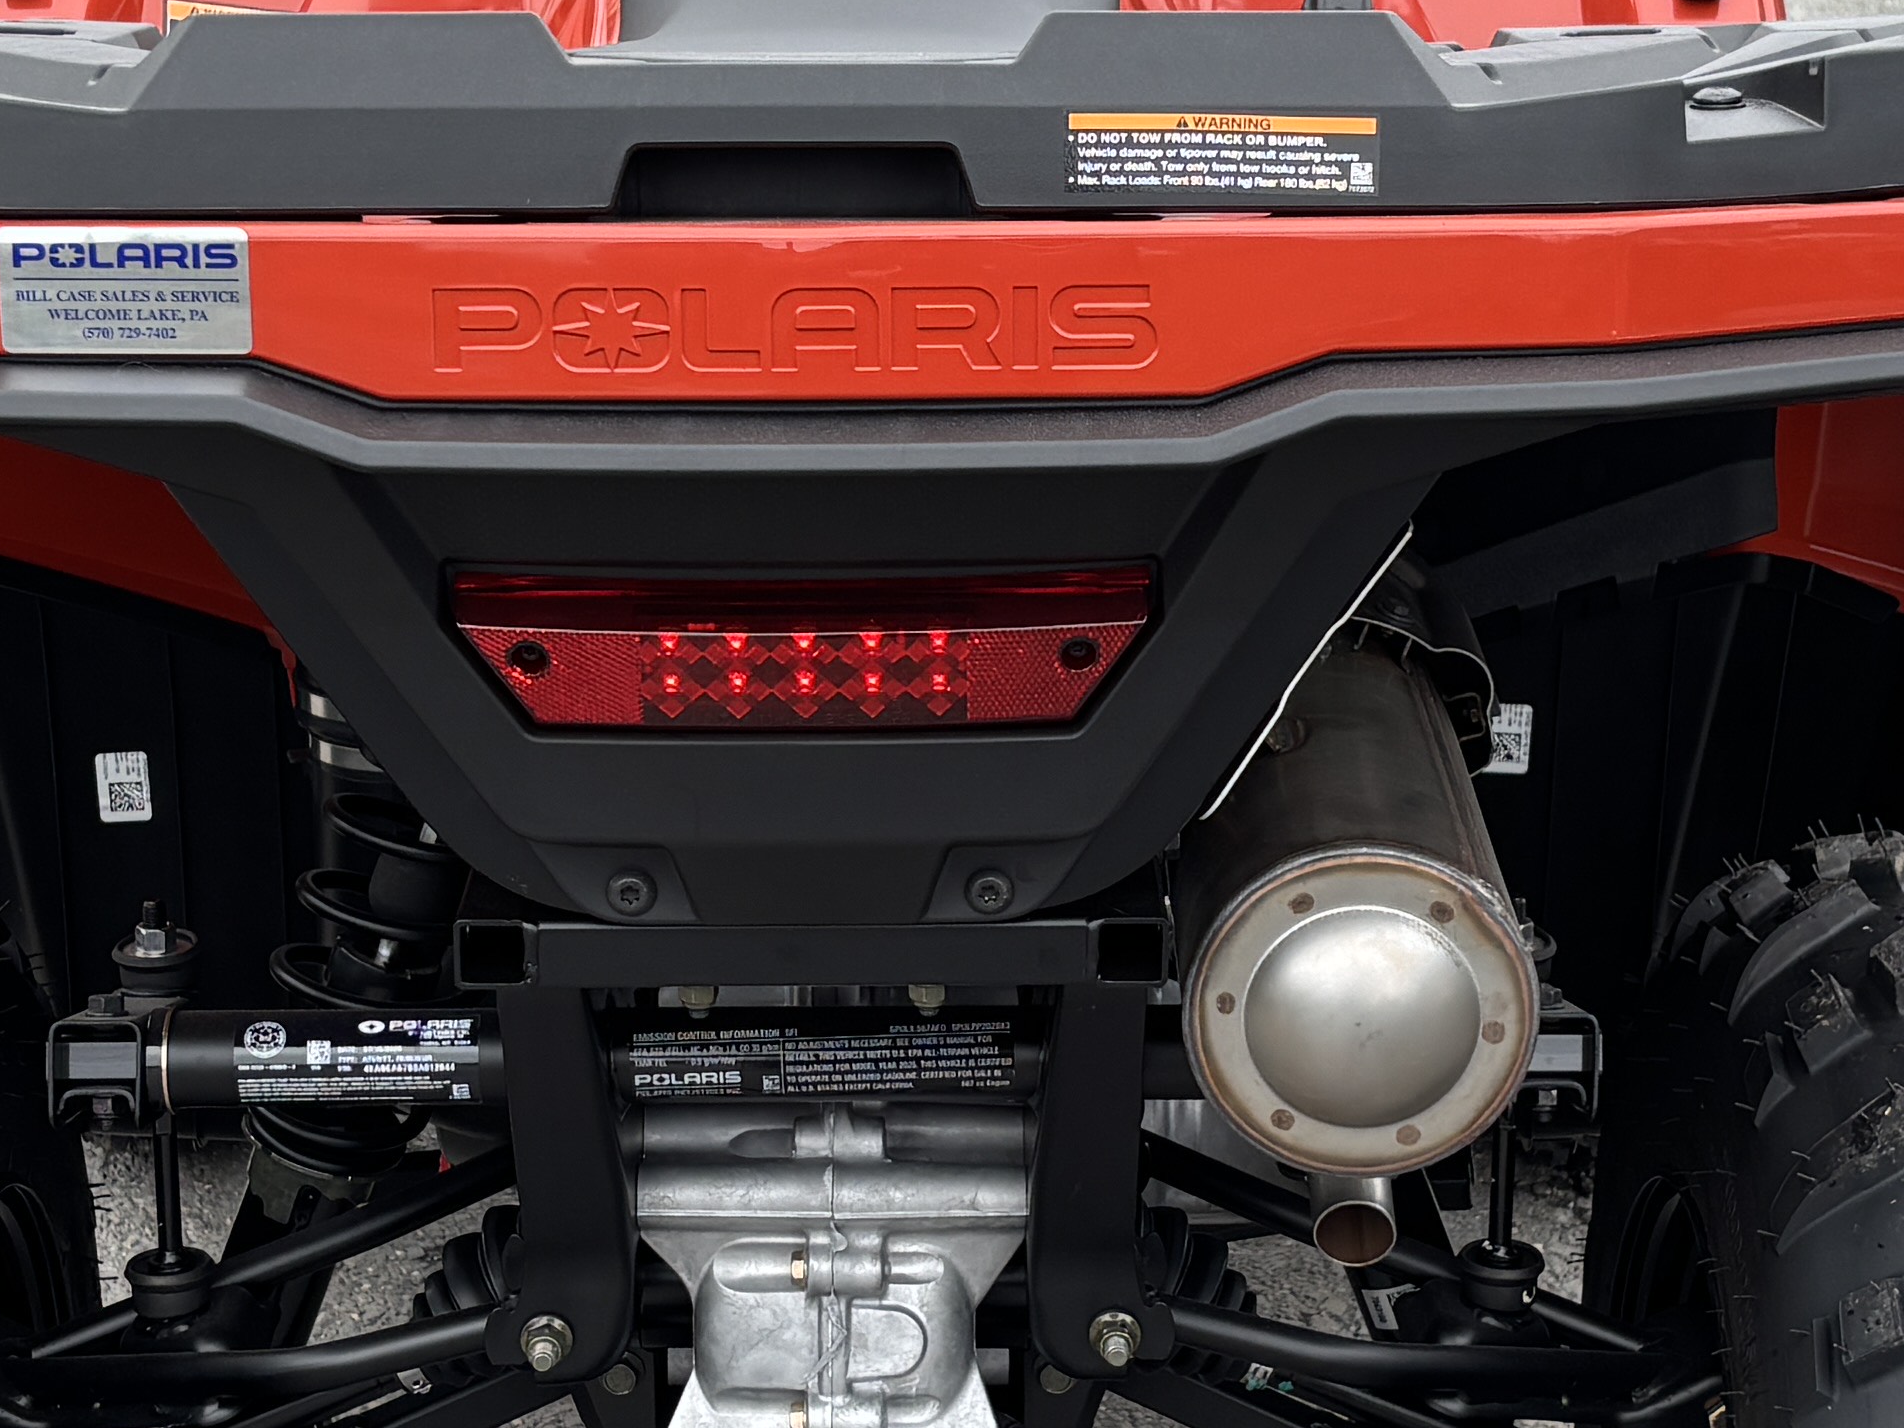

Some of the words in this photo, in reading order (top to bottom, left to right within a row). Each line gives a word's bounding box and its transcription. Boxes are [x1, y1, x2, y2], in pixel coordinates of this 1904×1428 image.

[1192, 116, 1271, 131] WARNING
[1077, 133, 1097, 144] DO
[1100, 133, 1128, 144] NOT
[1131, 133, 1161, 144] TOW
[1164, 133, 1202, 145] FROM
[1206, 134, 1242, 145] RACK
[1246, 135, 1265, 146] OR
[1268, 135, 1327, 147] BUMPER.
[1077, 147, 1117, 158] Vehicle
[1119, 148, 1163, 159] damage
[1166, 150, 1178, 158] or
[1220, 150, 1244, 161] may
[1246, 150, 1277, 160] result
[1278, 151, 1321, 163] causing
[1323, 153, 1360, 162] severe
[1109, 163, 1122, 172] or
[1124, 161, 1158, 172] death.
[1160, 161, 1185, 172] Tow
[1186, 162, 1209, 174] only
[1211, 162, 1238, 172] from
[1298, 165, 1310, 174] or
[1102, 175, 1127, 185] Rack
[1163, 176, 1189, 186] Front
[1254, 177, 1278, 187] Rear
[12, 242, 239, 270] POLARIS
[15, 290, 52, 302] BILL
[56, 290, 97, 302] CASE
[100, 290, 151, 302] SALES
[154, 290, 168, 302] &
[171, 291, 240, 303] SERVICE
[47, 308, 133, 321] WELCOME
[137, 309, 186, 324] LAKE,
[189, 309, 209, 322] PA
[82, 327, 114, 341] (570)
[117, 327, 177, 340] 729-7402
[431, 284, 1158, 372] POLARIS
[389, 1019, 471, 1031] POLARIS
[677, 1031, 717, 1041] CONTROL
[720, 1029, 780, 1039] INFORMATION
[634, 1071, 742, 1086] POLARIS
